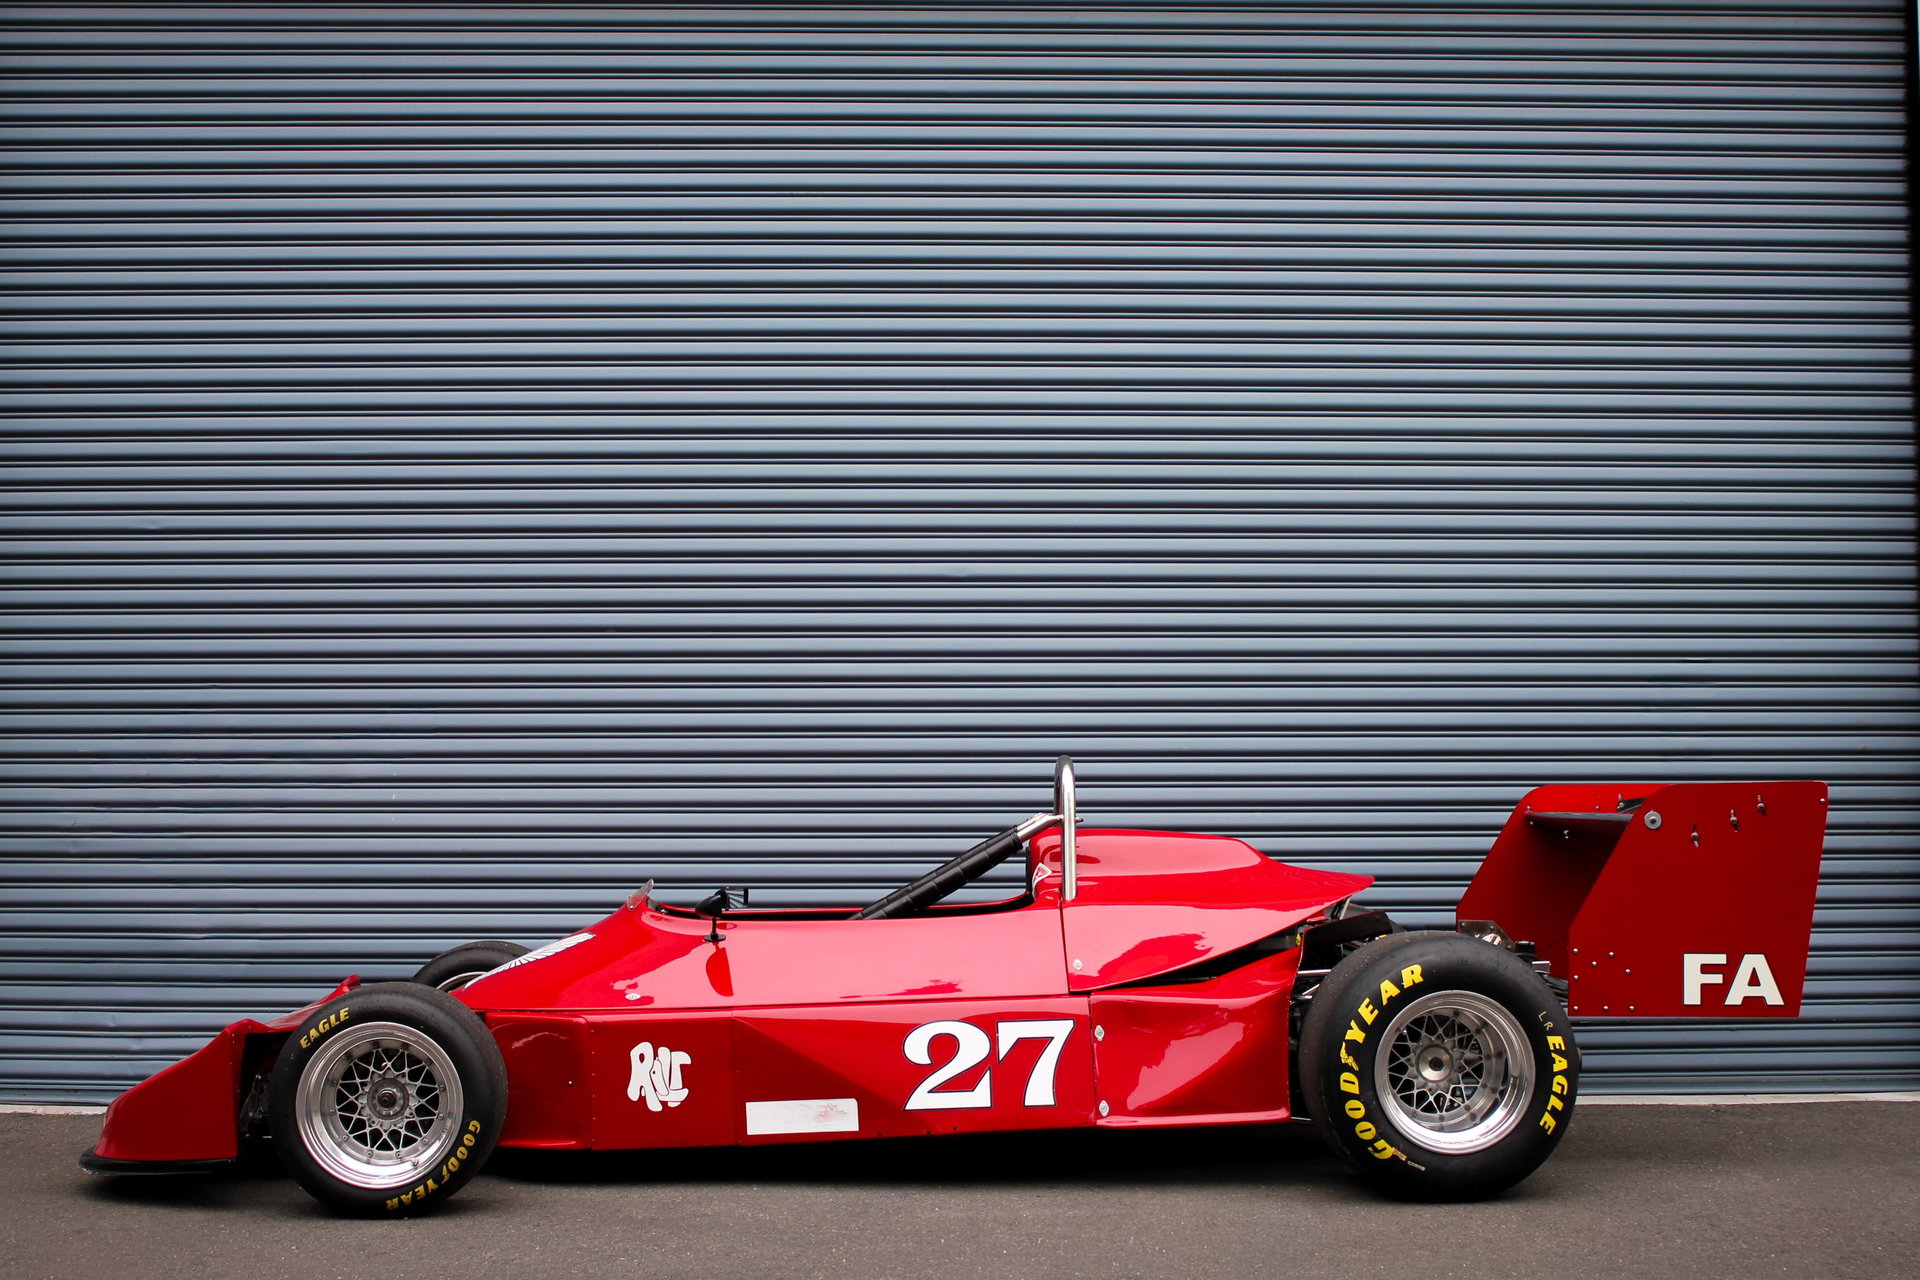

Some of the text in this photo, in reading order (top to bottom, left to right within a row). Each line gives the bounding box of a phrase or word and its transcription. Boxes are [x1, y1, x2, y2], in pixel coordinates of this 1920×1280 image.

[1683, 953, 1785, 1006] FA
[299, 1006, 350, 1050] EAGLE
[902, 1018, 1076, 1112] 27
[1339, 963, 1424, 1160] GOODYEAR
[1539, 1035, 1569, 1136] EAGLE
[385, 1119, 481, 1211] GOODYEAR
